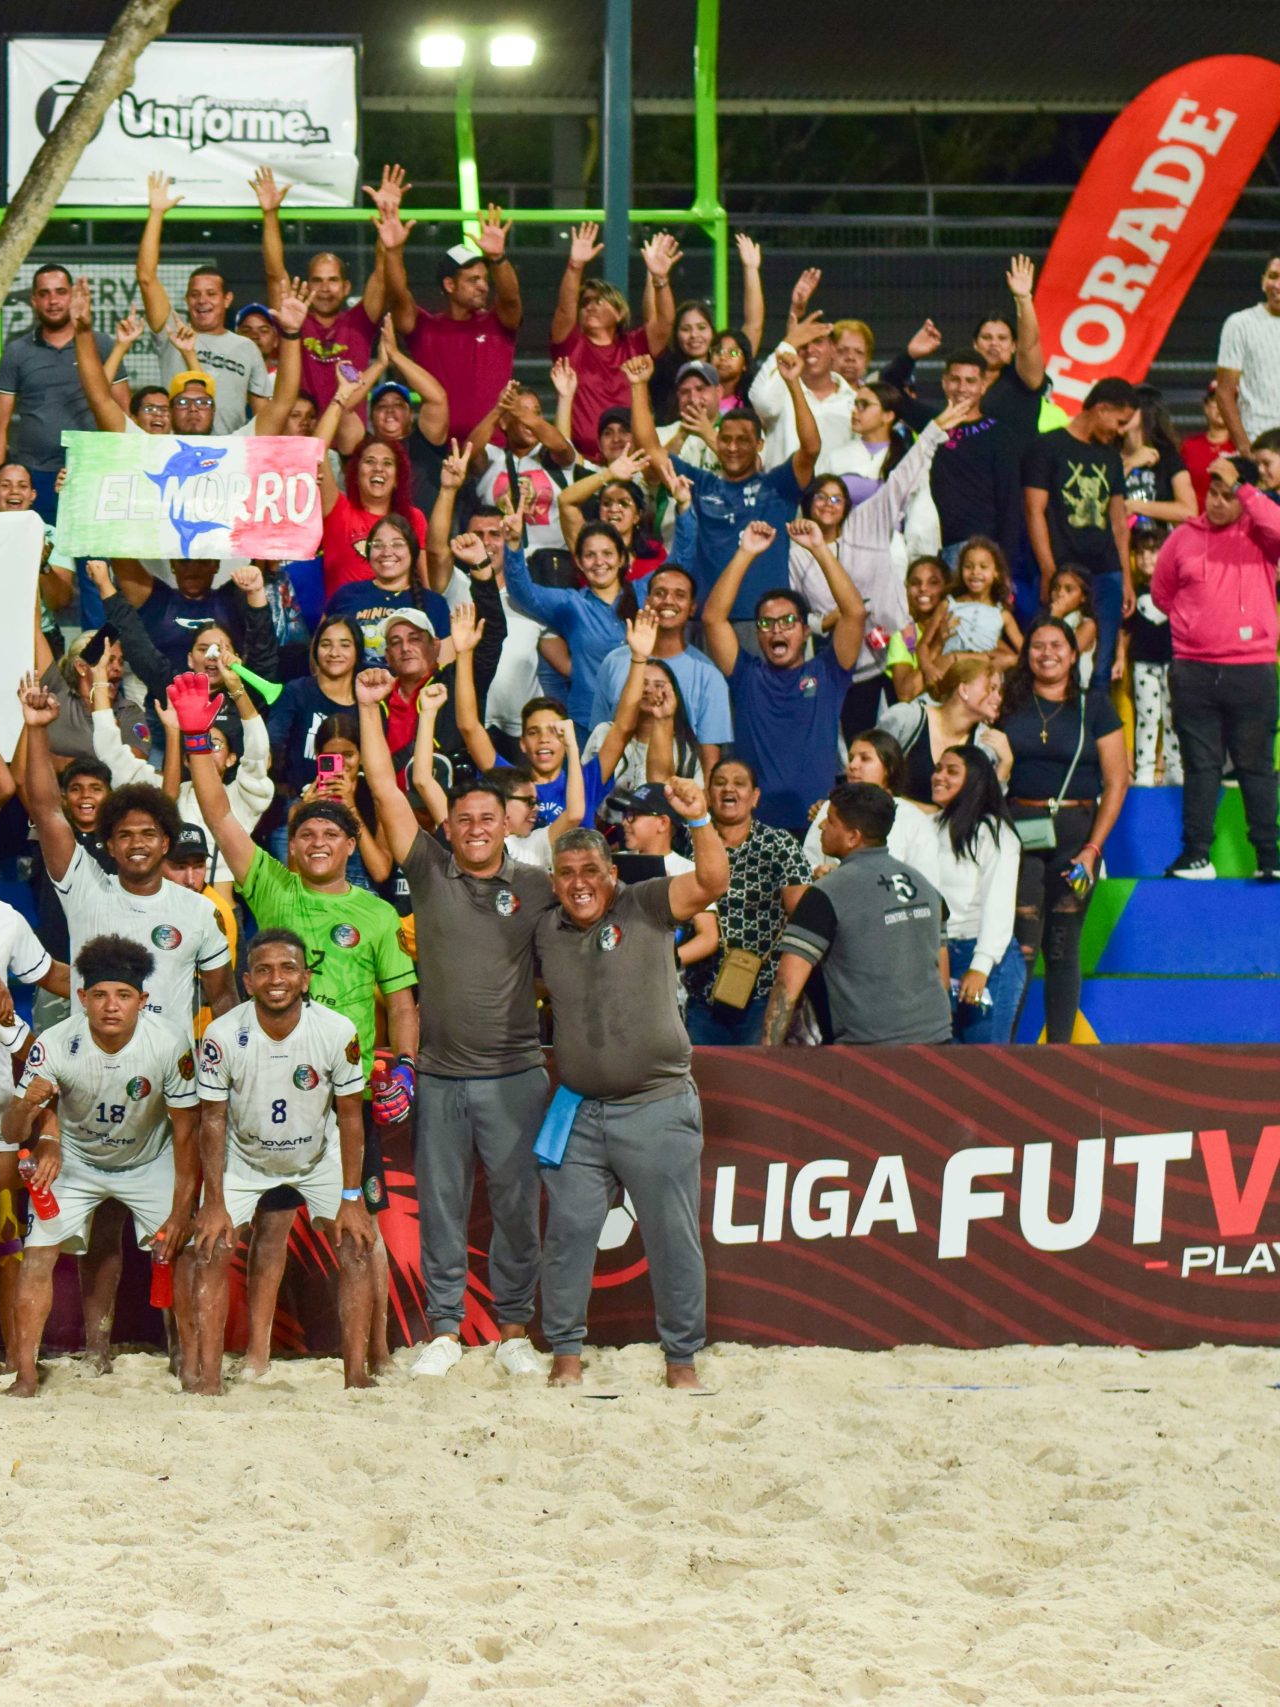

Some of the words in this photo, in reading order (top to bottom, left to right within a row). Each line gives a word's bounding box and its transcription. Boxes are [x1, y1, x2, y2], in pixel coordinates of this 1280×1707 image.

[121, 90, 310, 152] Uniforme
[1045, 97, 1238, 408] TORADE
[95, 474, 154, 521] EL
[160, 471, 318, 525] MORRO
[95, 1101, 126, 1124] 18
[271, 1098, 287, 1124] 8
[712, 1155, 918, 1245] LIGA
[937, 1125, 1280, 1260] FUTV
